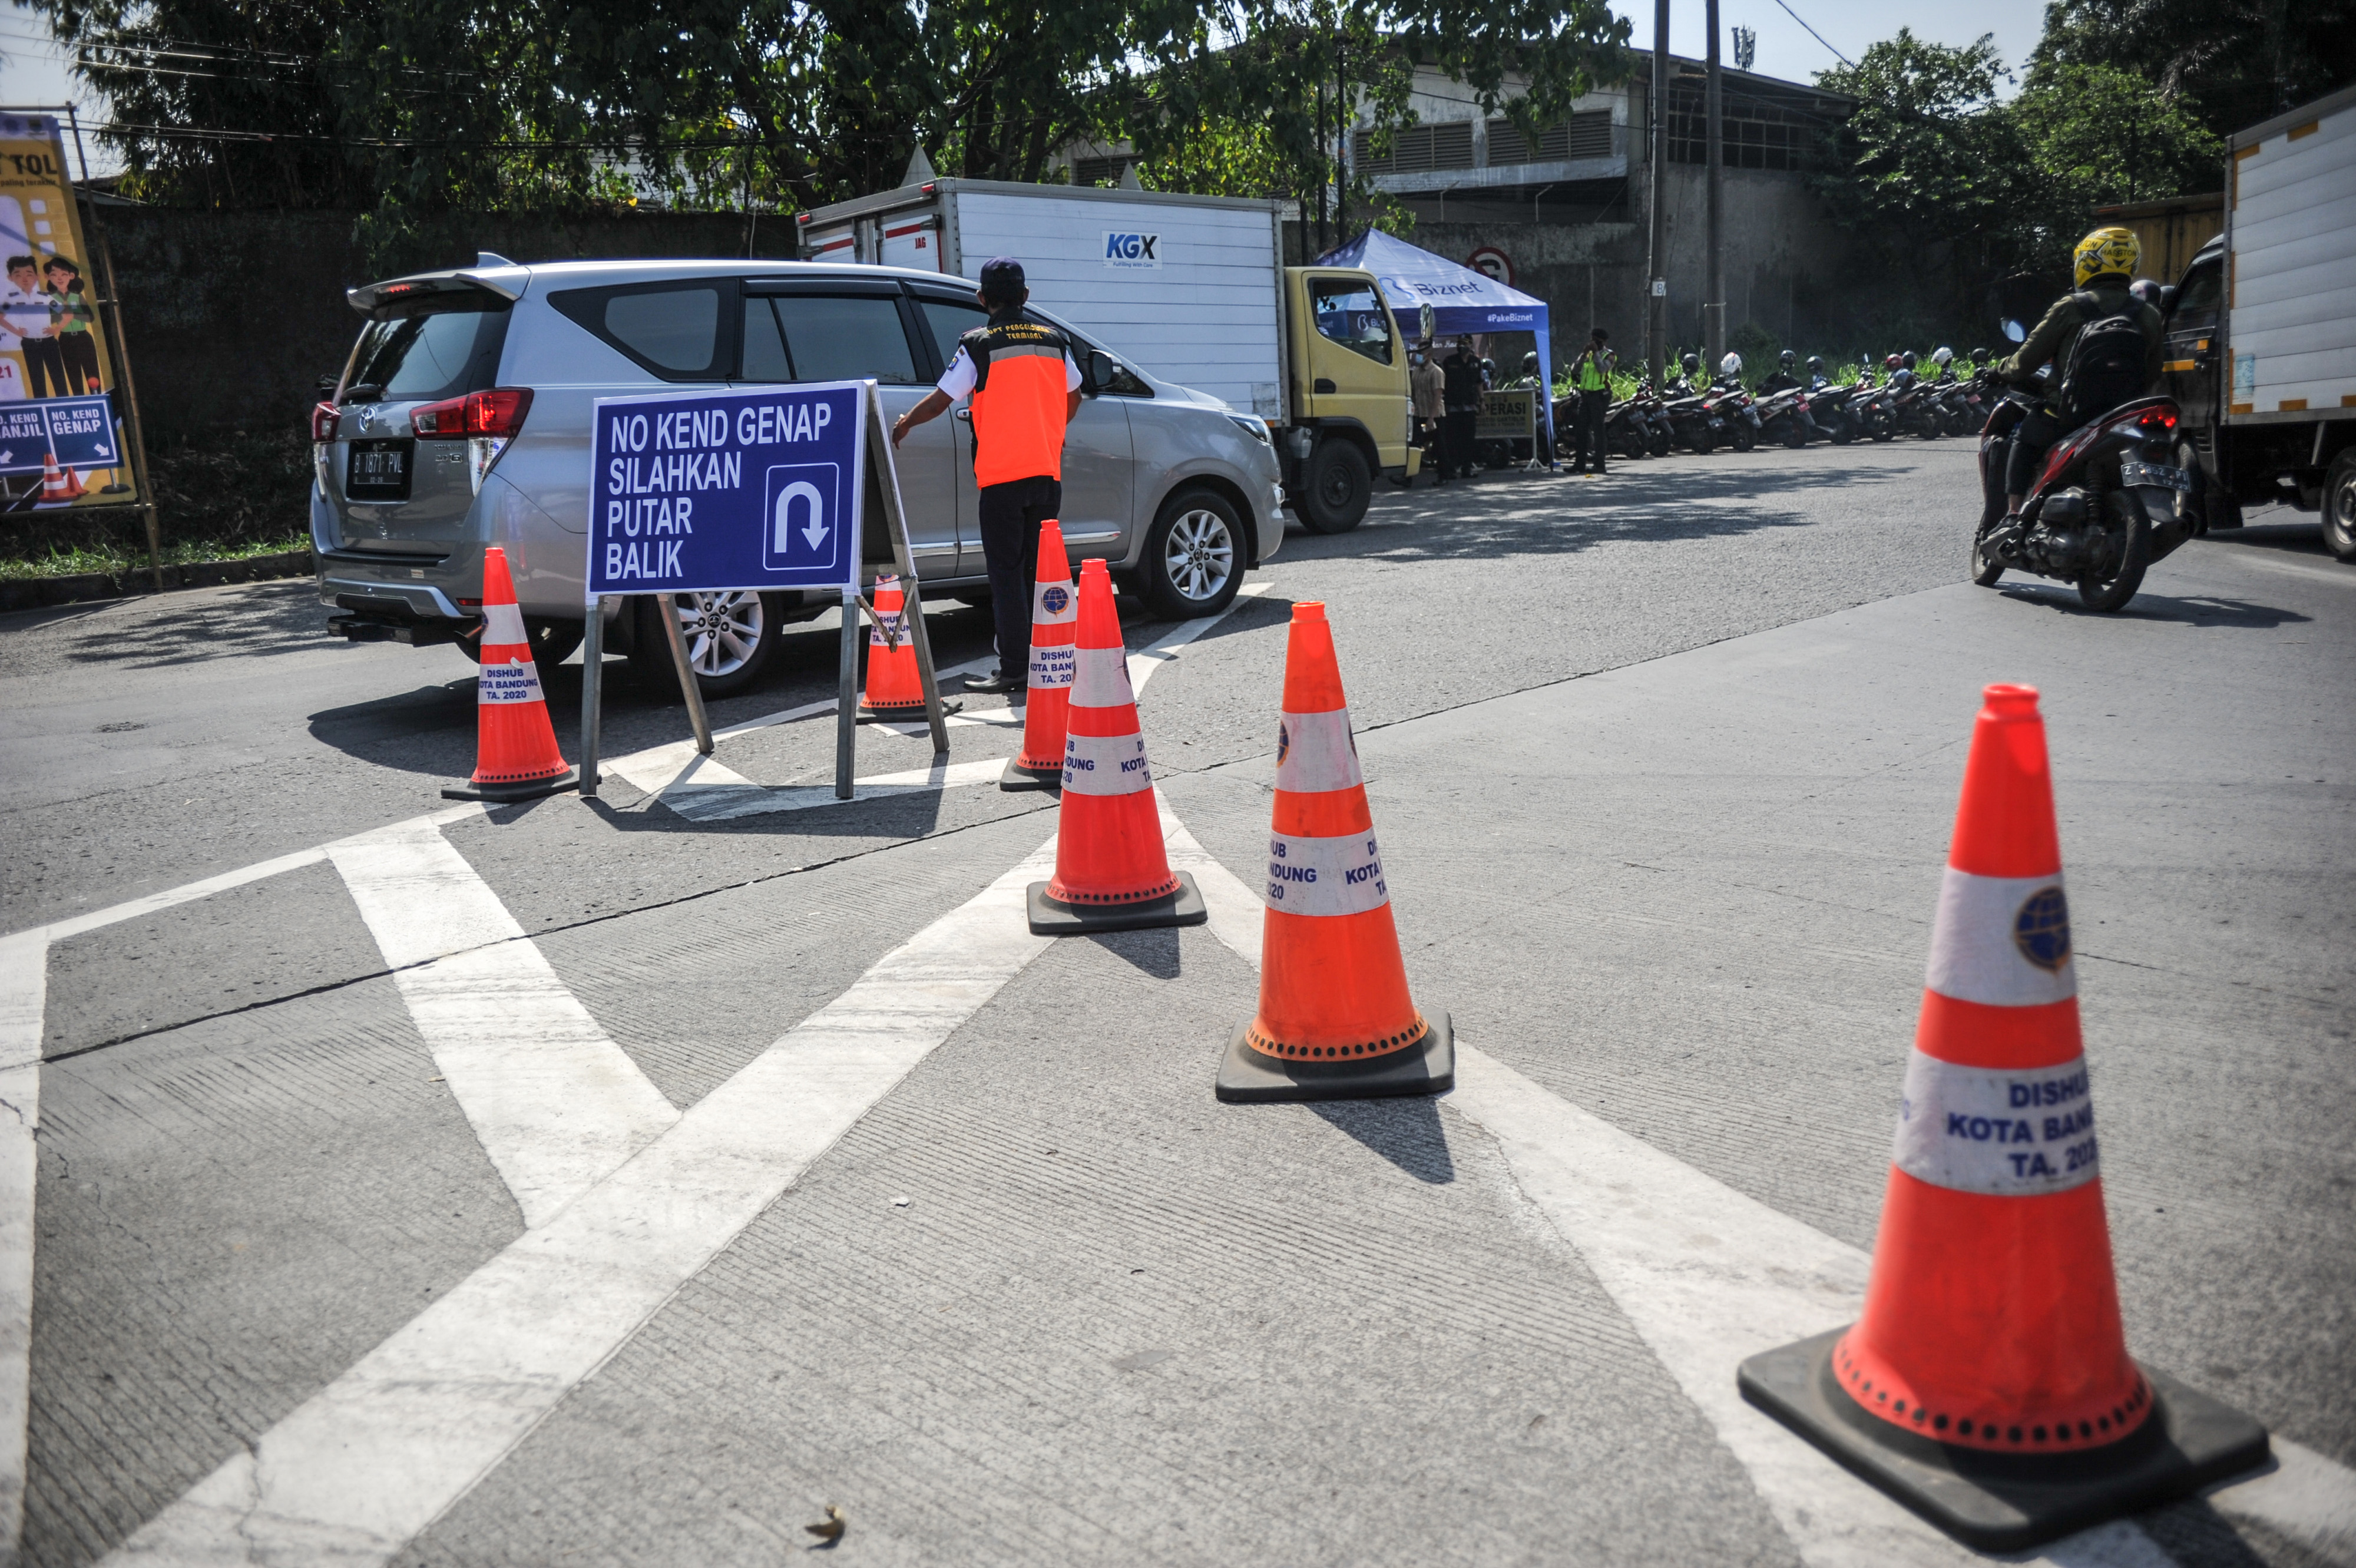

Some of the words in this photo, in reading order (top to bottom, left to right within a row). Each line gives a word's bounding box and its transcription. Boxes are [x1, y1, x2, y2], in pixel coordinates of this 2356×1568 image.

[9, 154, 57, 175] TOL
[915, 237, 926, 249] JAG
[1106, 234, 1157, 260] KGX
[1414, 282, 1483, 295] Biznet
[1487, 313, 1533, 322] #PakeBiznet
[987, 326, 1002, 335] UPT
[1006, 332, 1043, 340] TERMINAL
[10, 413, 38, 424] KEND
[51, 411, 70, 421] NO.
[72, 409, 100, 419] KEND
[0, 424, 44, 439] ANJIL
[53, 419, 101, 435] GENAP
[611, 414, 648, 453] NO
[656, 409, 728, 450] KEND
[737, 403, 831, 445] GENAP
[355, 454, 360, 473] B
[365, 454, 382, 473] 1871
[388, 453, 402, 473] PVL
[2123, 465, 2132, 475] Z
[609, 451, 741, 495] SILAHKAN
[607, 497, 693, 537] PUTAR
[605, 540, 684, 580] BALIK
[1041, 650, 1074, 660] DISHU
[487, 669, 524, 677] DISHUB
[1041, 675, 1056, 683] TA.
[495, 679, 538, 689] BANDUNG
[487, 692, 499, 700] TA.
[503, 690, 527, 699] 2020
[1121, 756, 1146, 773] KOTA
[1345, 862, 1379, 885] KOTA
[1947, 1112, 2034, 1143] KOTA
[2008, 1152, 2057, 1177] TA.
